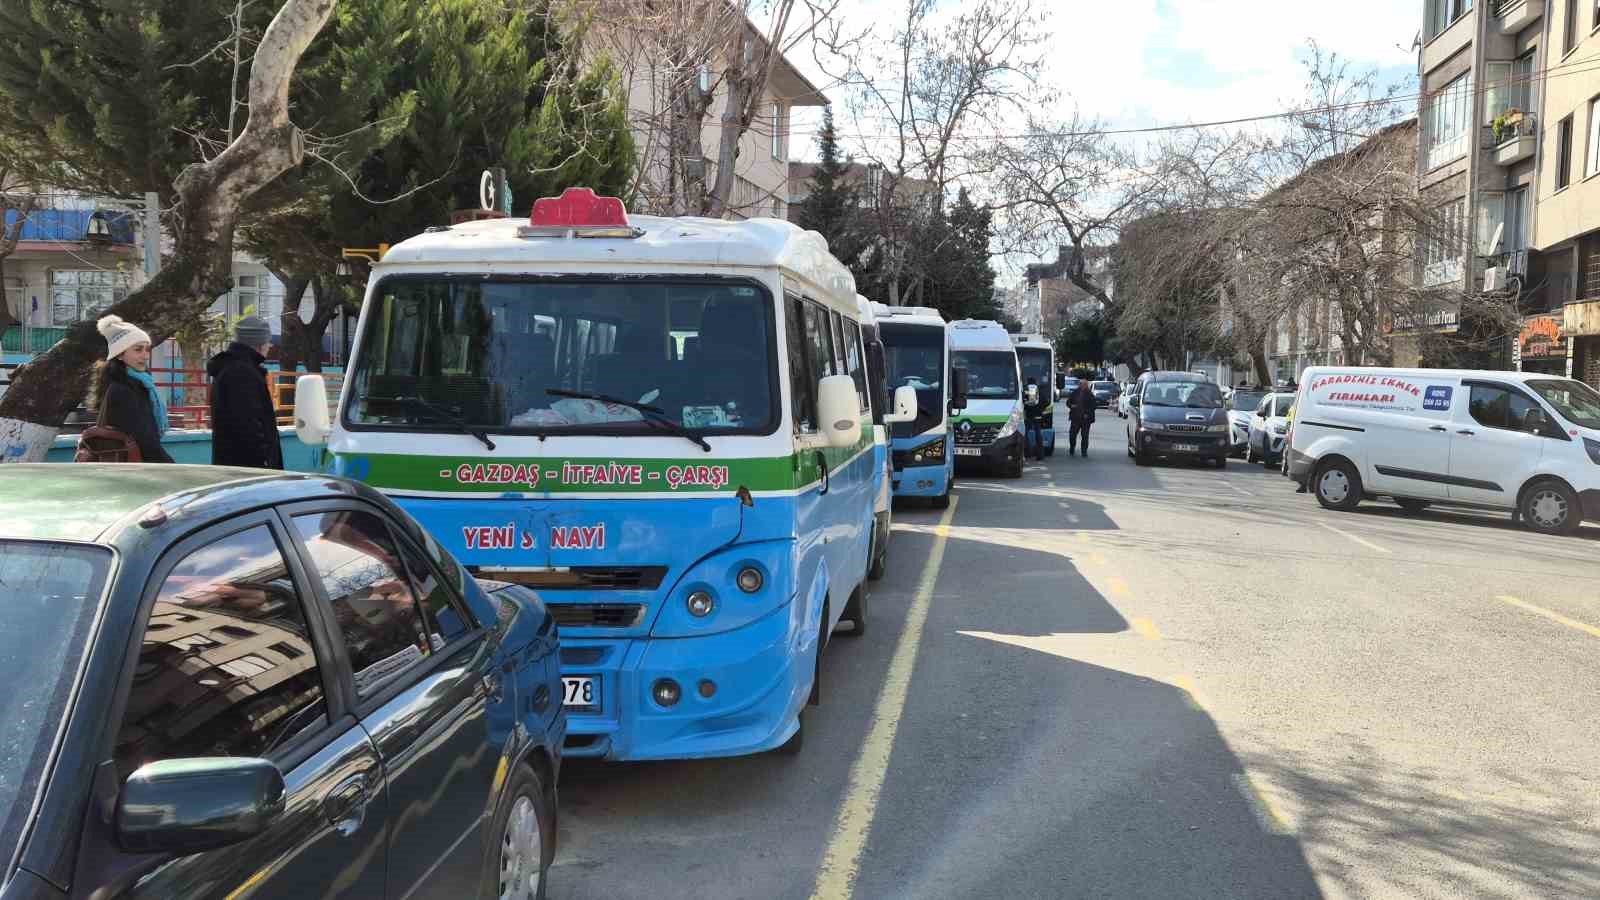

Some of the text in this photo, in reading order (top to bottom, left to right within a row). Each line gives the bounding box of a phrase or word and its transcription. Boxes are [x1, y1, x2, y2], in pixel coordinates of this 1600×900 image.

[1381, 377, 1421, 396] EKMEK
[456, 463, 540, 488] GAZDAŞ
[562, 461, 643, 484] İTFAİYE
[666, 465, 729, 489] ÇARŞI
[463, 521, 515, 549] YENİ
